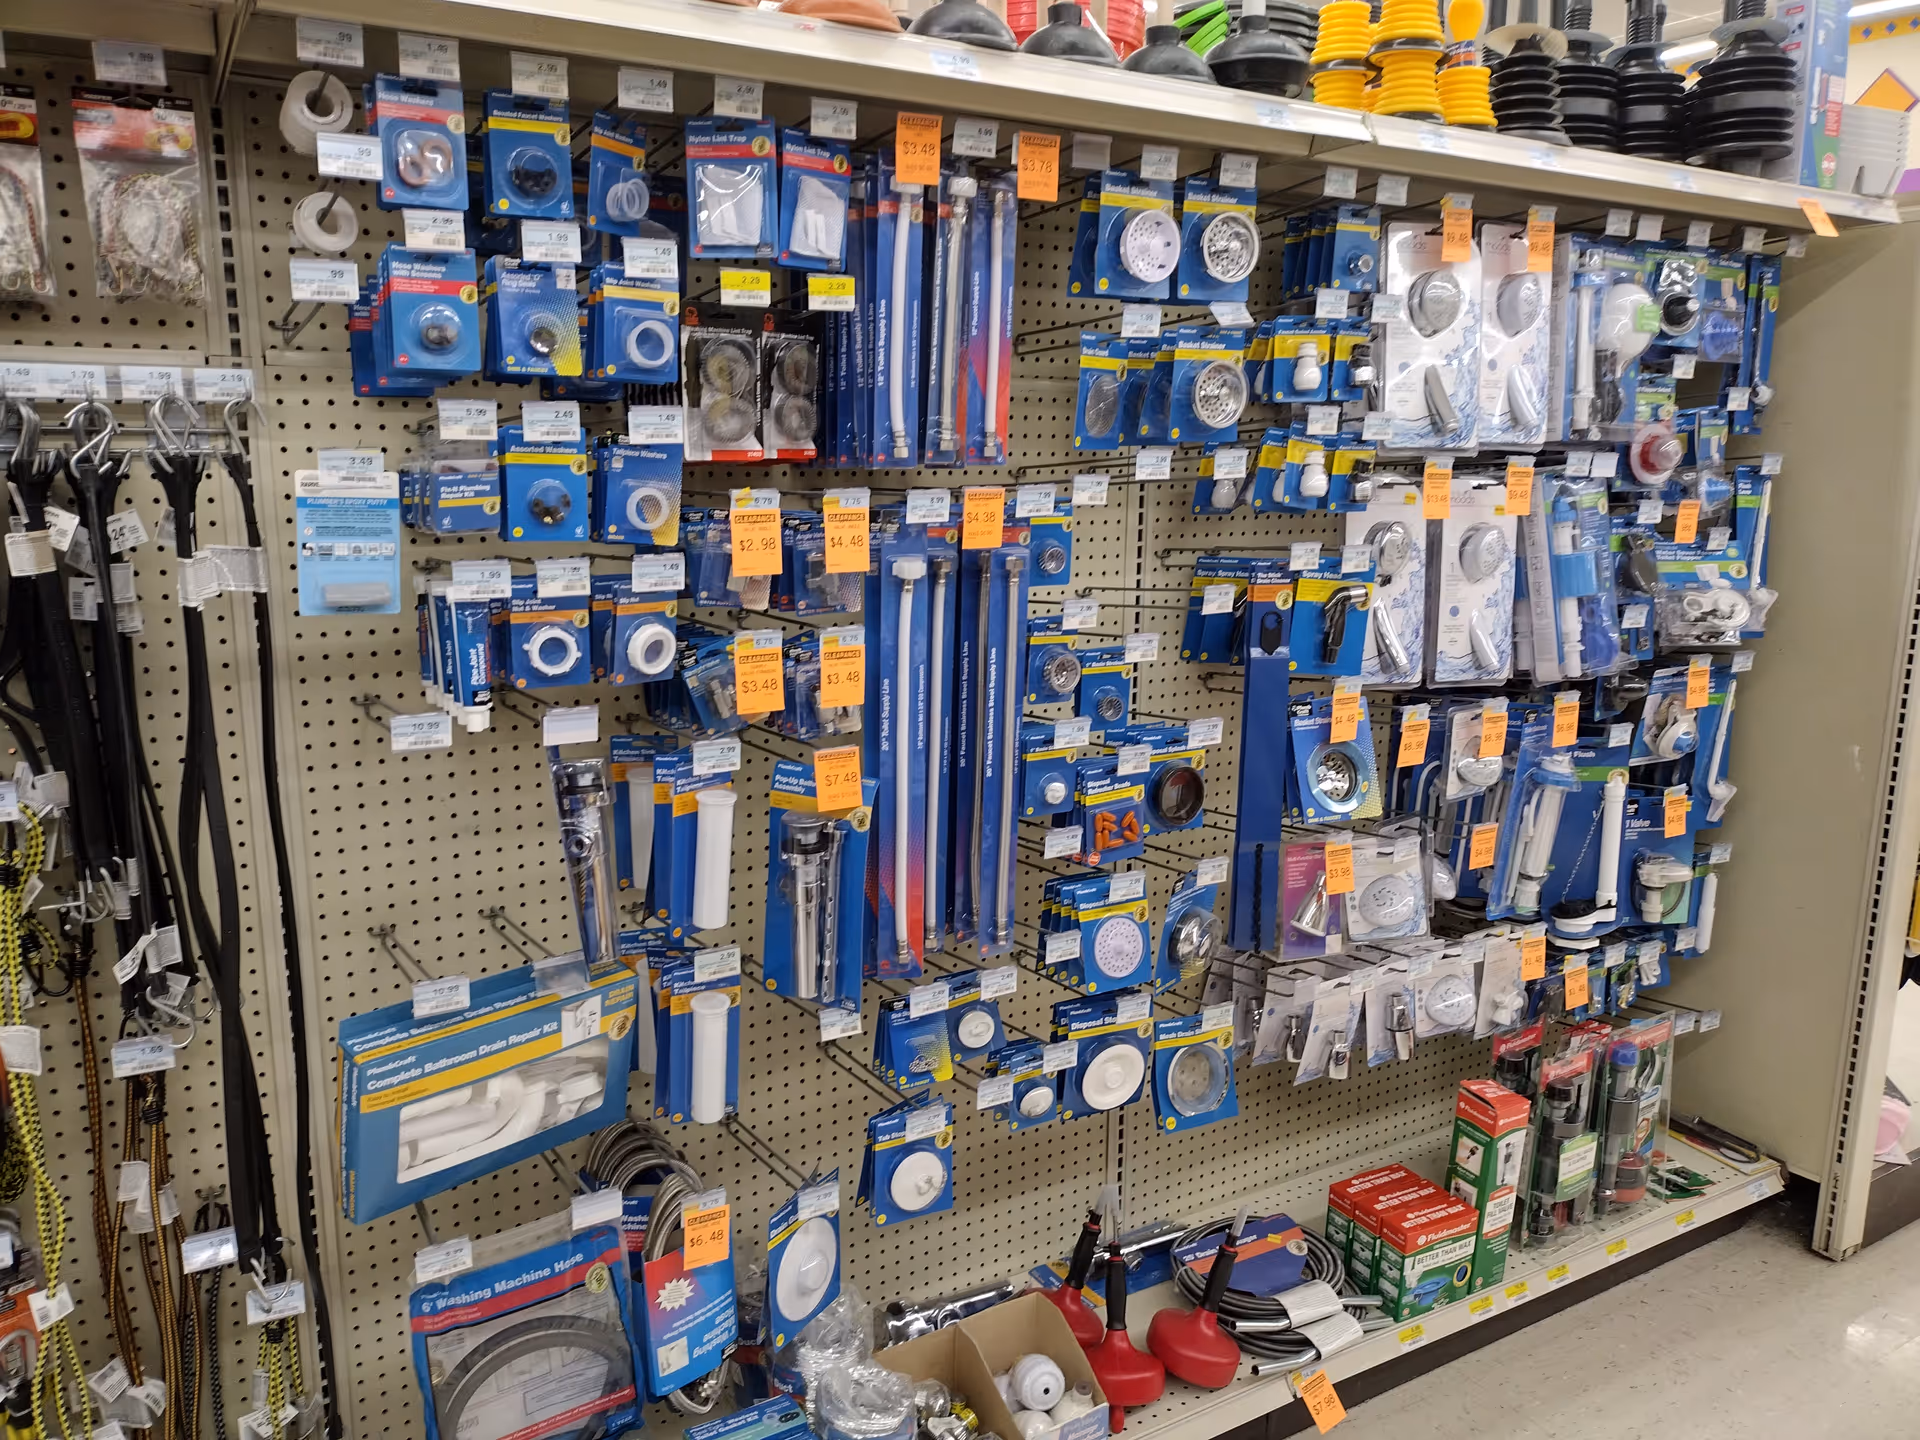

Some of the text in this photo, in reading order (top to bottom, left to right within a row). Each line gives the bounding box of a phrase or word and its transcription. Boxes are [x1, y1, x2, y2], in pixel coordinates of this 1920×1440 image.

[902, 141, 936, 156] $3.48
[1021, 158, 1052, 173] $3.78
[966, 512, 996, 524] $4.38
[739, 538, 776, 552] $2.98
[830, 535, 863, 548] $4.48
[826, 671, 860, 685] $3.48
[989, 664, 997, 688] Supply
[741, 679, 778, 694] $3.48
[988, 688, 996, 707] Steel
[824, 772, 857, 787] $7.48
[367, 1021, 558, 1090] Complete Bathroom Drain Repair Kit
[690, 1230, 725, 1247] $6.48
[1427, 1222, 1472, 1242] Fluidmaster
[1417, 1252, 1439, 1265] BETTER
[1441, 1247, 1457, 1258] THAN
[1458, 1240, 1473, 1253] WAX
[435, 1252, 584, 1310] Washing Machine Hose
